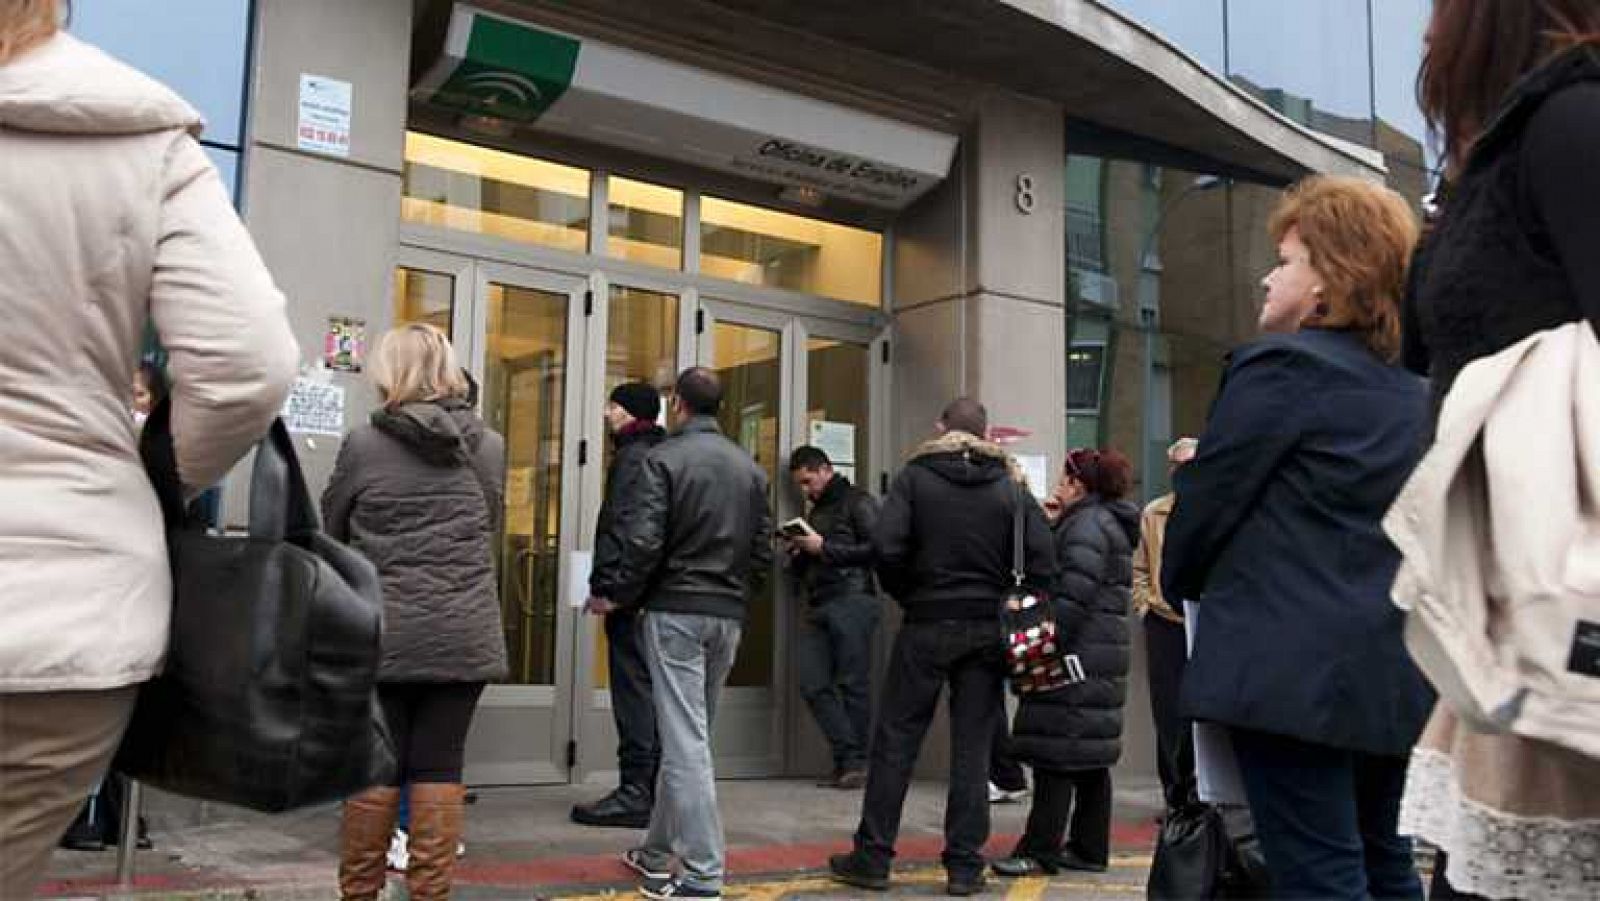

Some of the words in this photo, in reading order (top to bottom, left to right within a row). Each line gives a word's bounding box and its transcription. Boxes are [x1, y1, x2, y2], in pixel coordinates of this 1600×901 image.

[758, 139, 827, 170] Oficina
[827, 153, 850, 173] de
[1016, 174, 1034, 215] 8
